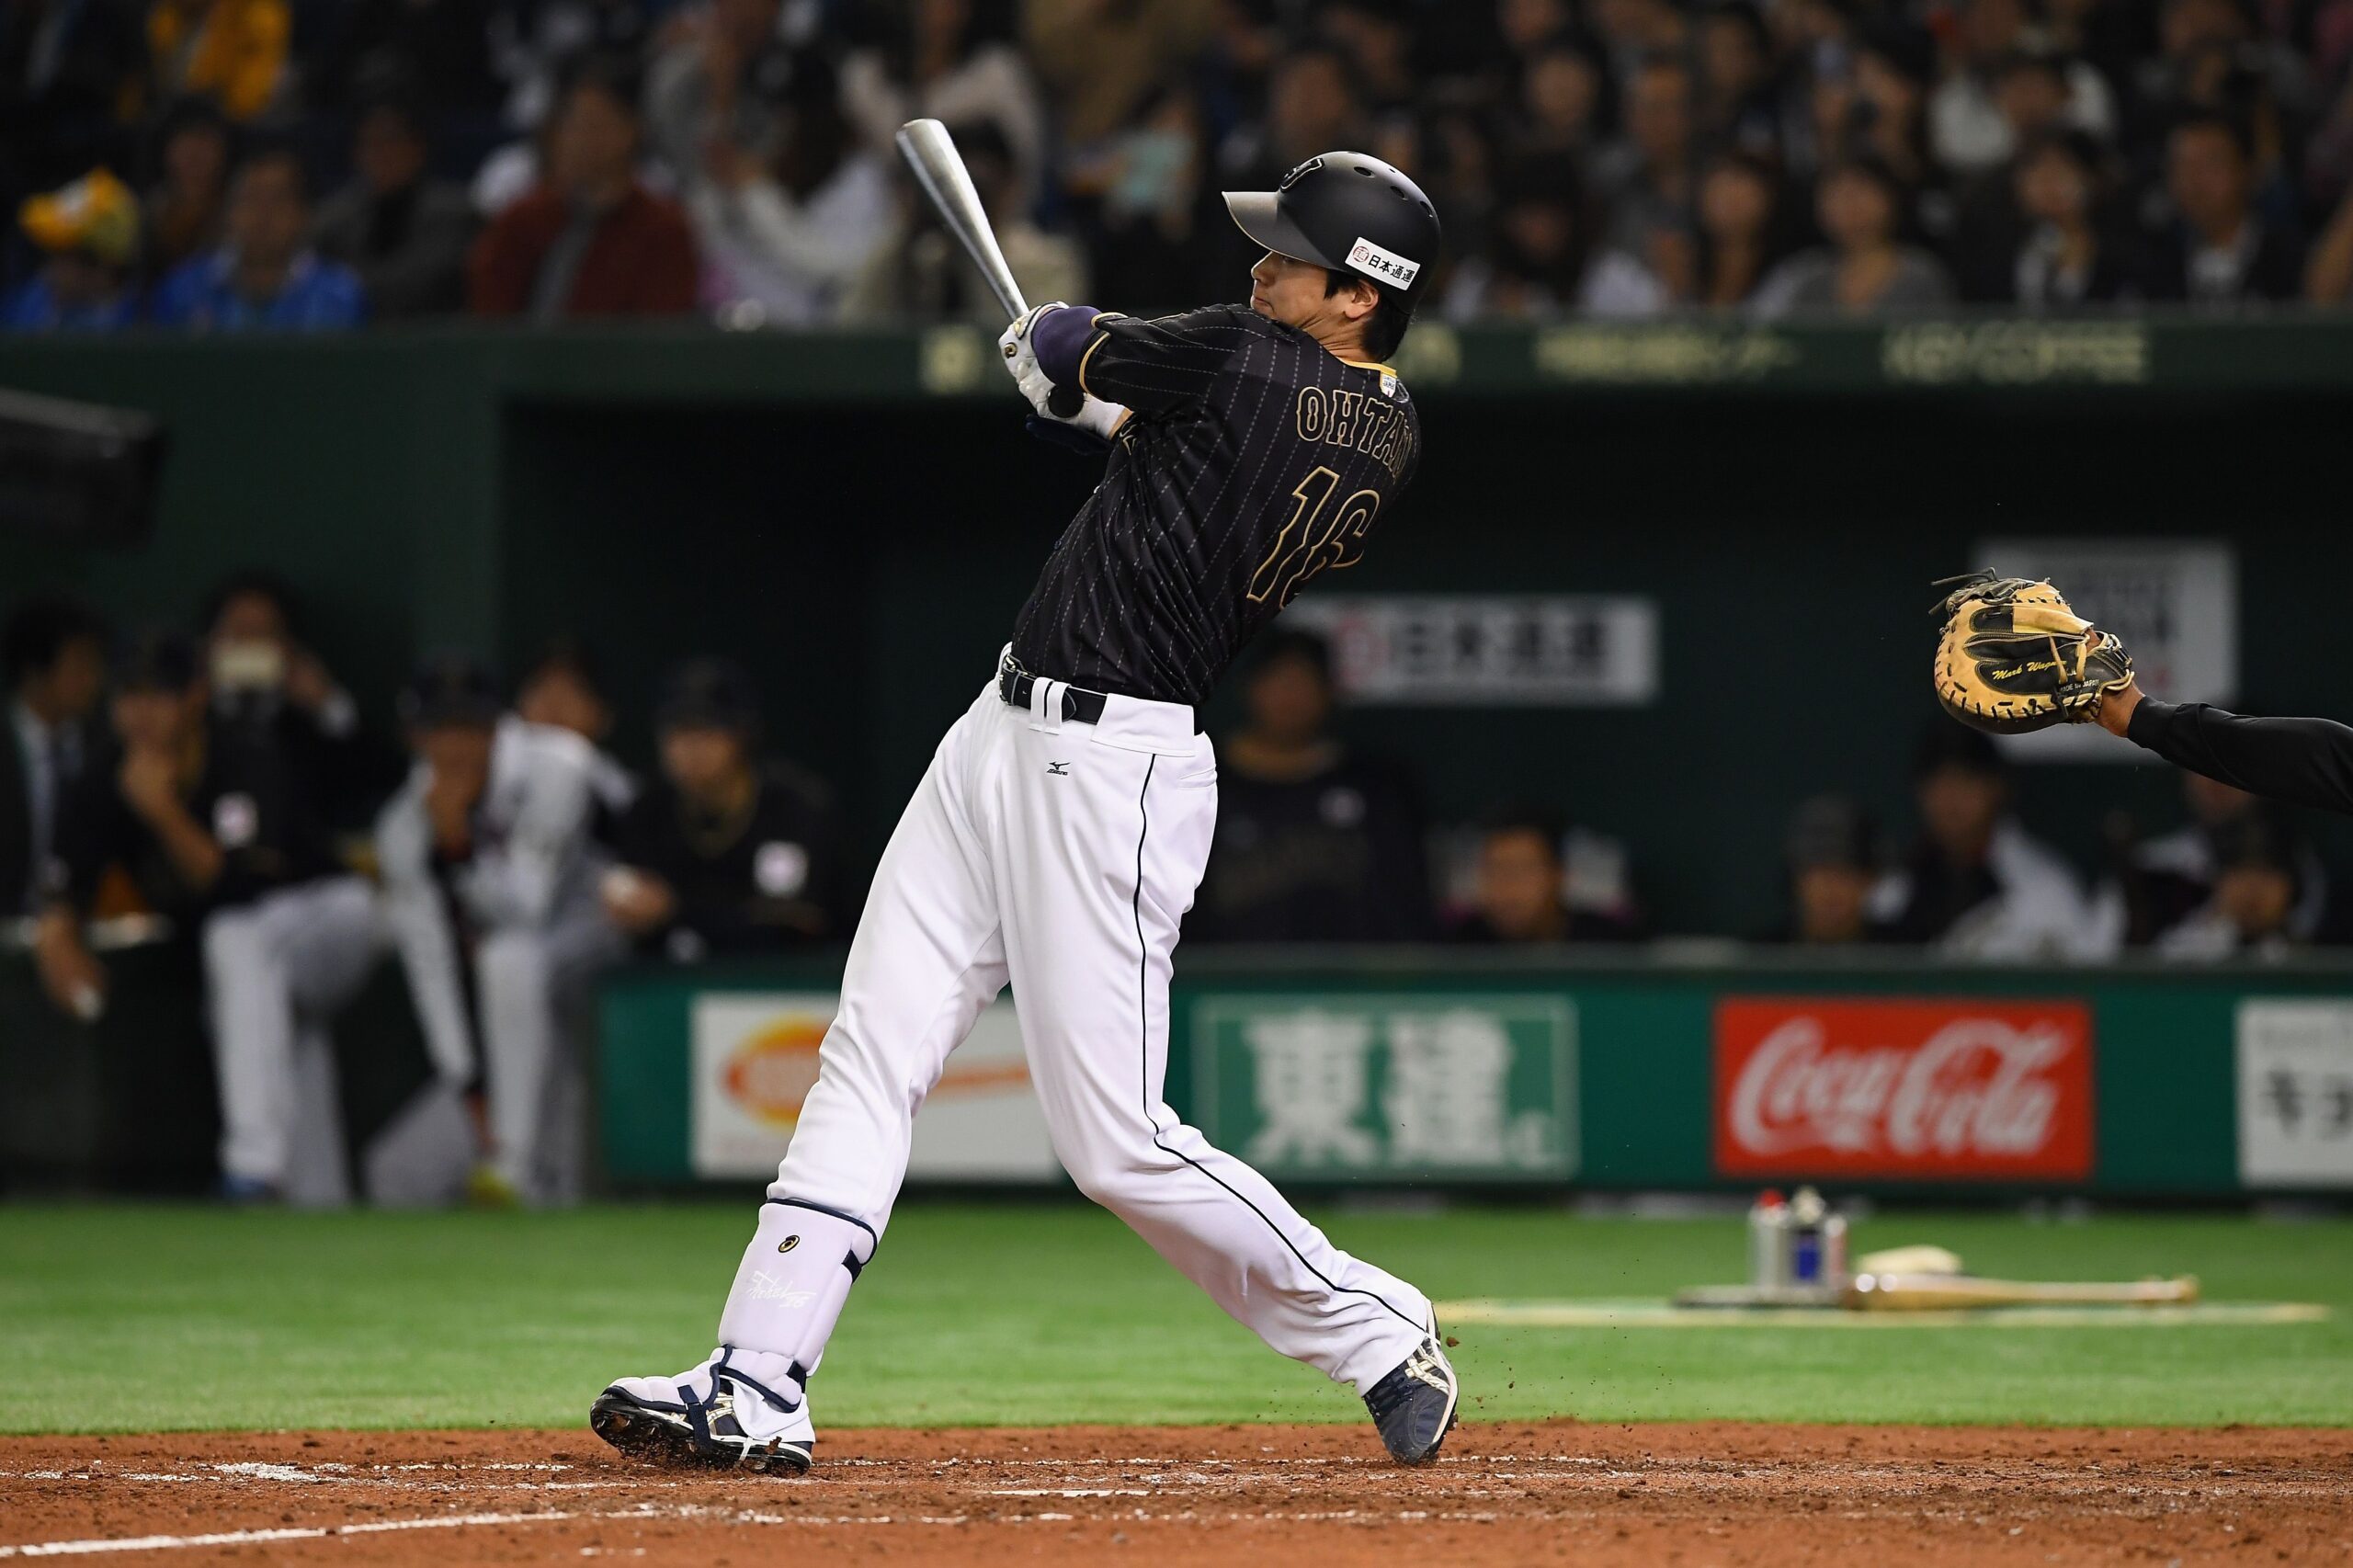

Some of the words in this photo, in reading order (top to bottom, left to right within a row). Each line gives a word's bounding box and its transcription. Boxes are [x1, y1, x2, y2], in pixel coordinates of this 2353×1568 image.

[1368, 254, 1415, 283] 日本通運
[1246, 465, 1380, 609] 16
[1992, 664, 2023, 680] Mark
